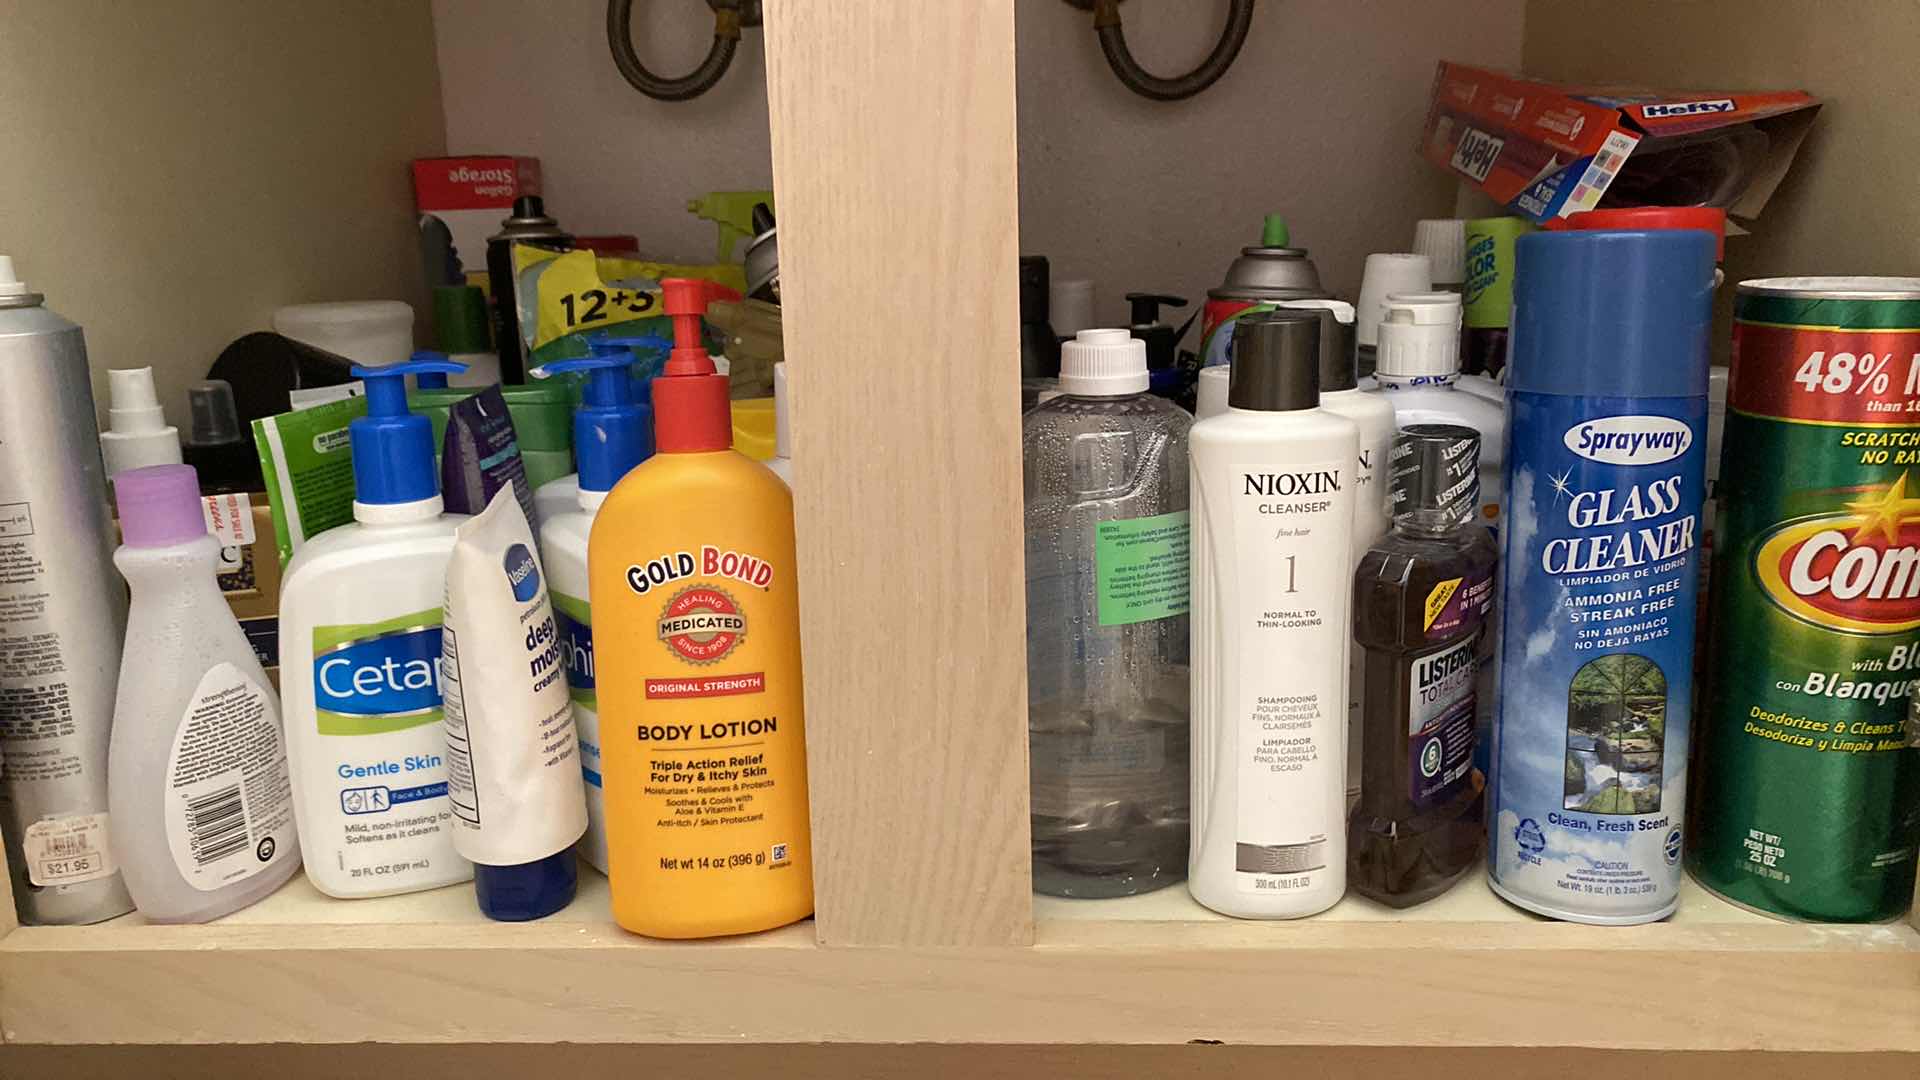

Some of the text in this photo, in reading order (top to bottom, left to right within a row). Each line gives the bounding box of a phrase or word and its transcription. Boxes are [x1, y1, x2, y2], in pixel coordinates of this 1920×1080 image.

[1646, 102, 1729, 116] Hefty
[1459, 131, 1499, 177] Hefty
[448, 166, 512, 183] Storage
[1795, 352, 1893, 395] 48%
[1867, 400, 1902, 412] than
[1861, 450, 1889, 464] NO
[1568, 476, 1681, 528] GLASS
[1275, 528, 1311, 539] fine hair
[1542, 515, 1695, 574] CLEANER
[628, 545, 773, 593] GOLD BOND
[1285, 556, 1298, 593] 1
[1559, 558, 1686, 586] LIMPIADOR DE VIDRIO
[1564, 579, 1680, 607] AMMONIA FREE
[678, 594, 722, 610] HEALING
[1570, 597, 1675, 623] STREAK FREE
[1264, 611, 1302, 619] NORMAL
[662, 618, 743, 633] MEDICATED
[1257, 619, 1322, 628] THIN-LOOKING
[1578, 617, 1668, 639] SIN AMONIACO
[526, 616, 553, 651] deep
[1575, 628, 1669, 650] NO DEJA RAYAS
[678, 636, 728, 655] SINCE 1908
[1851, 659, 1884, 672] with
[649, 678, 760, 693] ORIGINAL STRENGTH
[1420, 678, 1454, 705] TOTAL
[1776, 680, 1801, 692] con
[1258, 695, 1317, 704] SHAMPOOING
[1281, 704, 1318, 712] CHEVEUX
[1274, 712, 1315, 721] NORMAUX
[1750, 705, 1895, 736] Deodorizes & Cleans
[638, 717, 777, 741] BODY LOTION
[1263, 738, 1311, 746] LIMPIADOR
[1744, 722, 1873, 753] Desodoriza y Limpia
[1281, 745, 1316, 754] CABELLO
[338, 755, 441, 778] Gentle Skin
[650, 754, 763, 771] Triple Action Relief
[1271, 763, 1302, 771] ESCASO
[1277, 755, 1310, 763] NORMAL
[651, 766, 767, 783] For Dry & Itchy Skin
[644, 787, 688, 795] Moisturizes
[741, 780, 774, 790] Protects
[392, 792, 413, 800] Face
[666, 799, 699, 807] Soothes
[705, 806, 736, 814] Vitamin
[345, 815, 437, 832] Mild, non-irritating
[720, 814, 763, 824] Protectant
[1548, 813, 1668, 832] Clean, Fresh Scent
[346, 834, 383, 844] Softens
[408, 826, 440, 837] cleans
[1750, 829, 1764, 841] NET
[1744, 838, 1784, 858] PESO NETO
[47, 859, 89, 874] $21.95
[660, 851, 765, 869] Net wt 14 oz (396 g)
[1594, 861, 1628, 869] CAUTION
[1750, 851, 1776, 867] 25 OZ
[375, 866, 391, 874] OZ
[1558, 880, 1570, 890] Net
